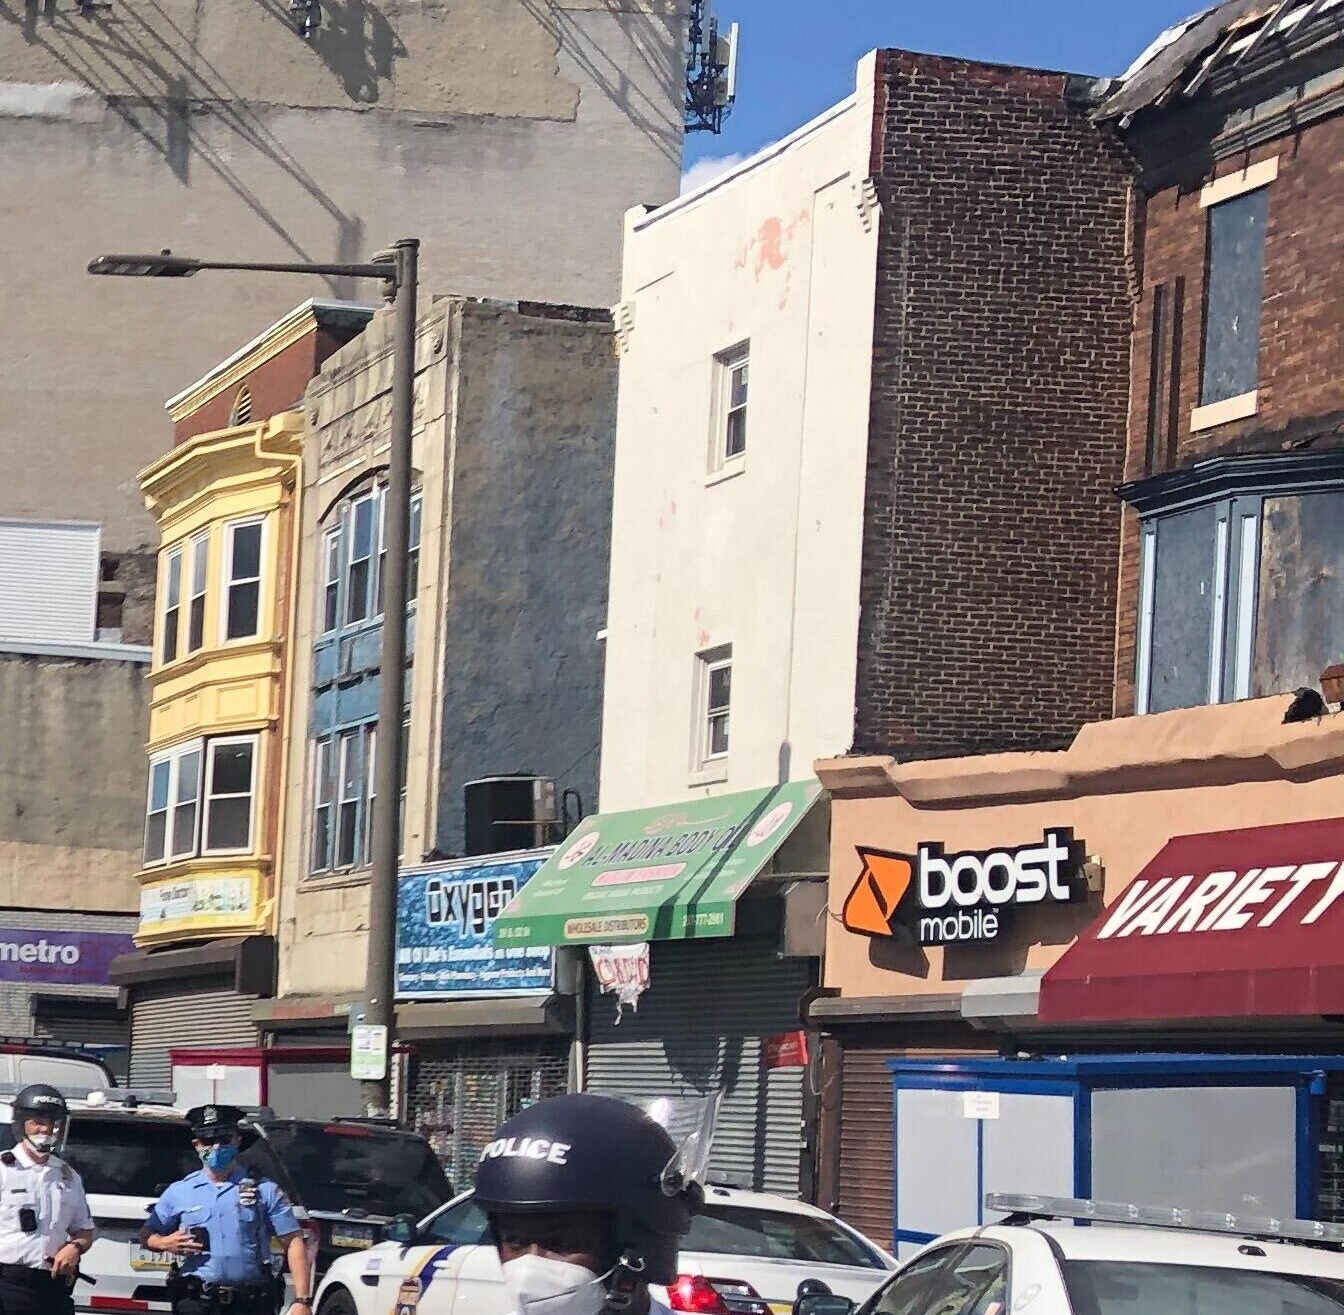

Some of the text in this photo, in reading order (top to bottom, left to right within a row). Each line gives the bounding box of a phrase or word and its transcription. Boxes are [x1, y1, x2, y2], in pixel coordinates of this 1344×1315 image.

[919, 832, 1070, 909] boost
[919, 908, 999, 942] mobile
[479, 1137, 571, 1165] POLICE
